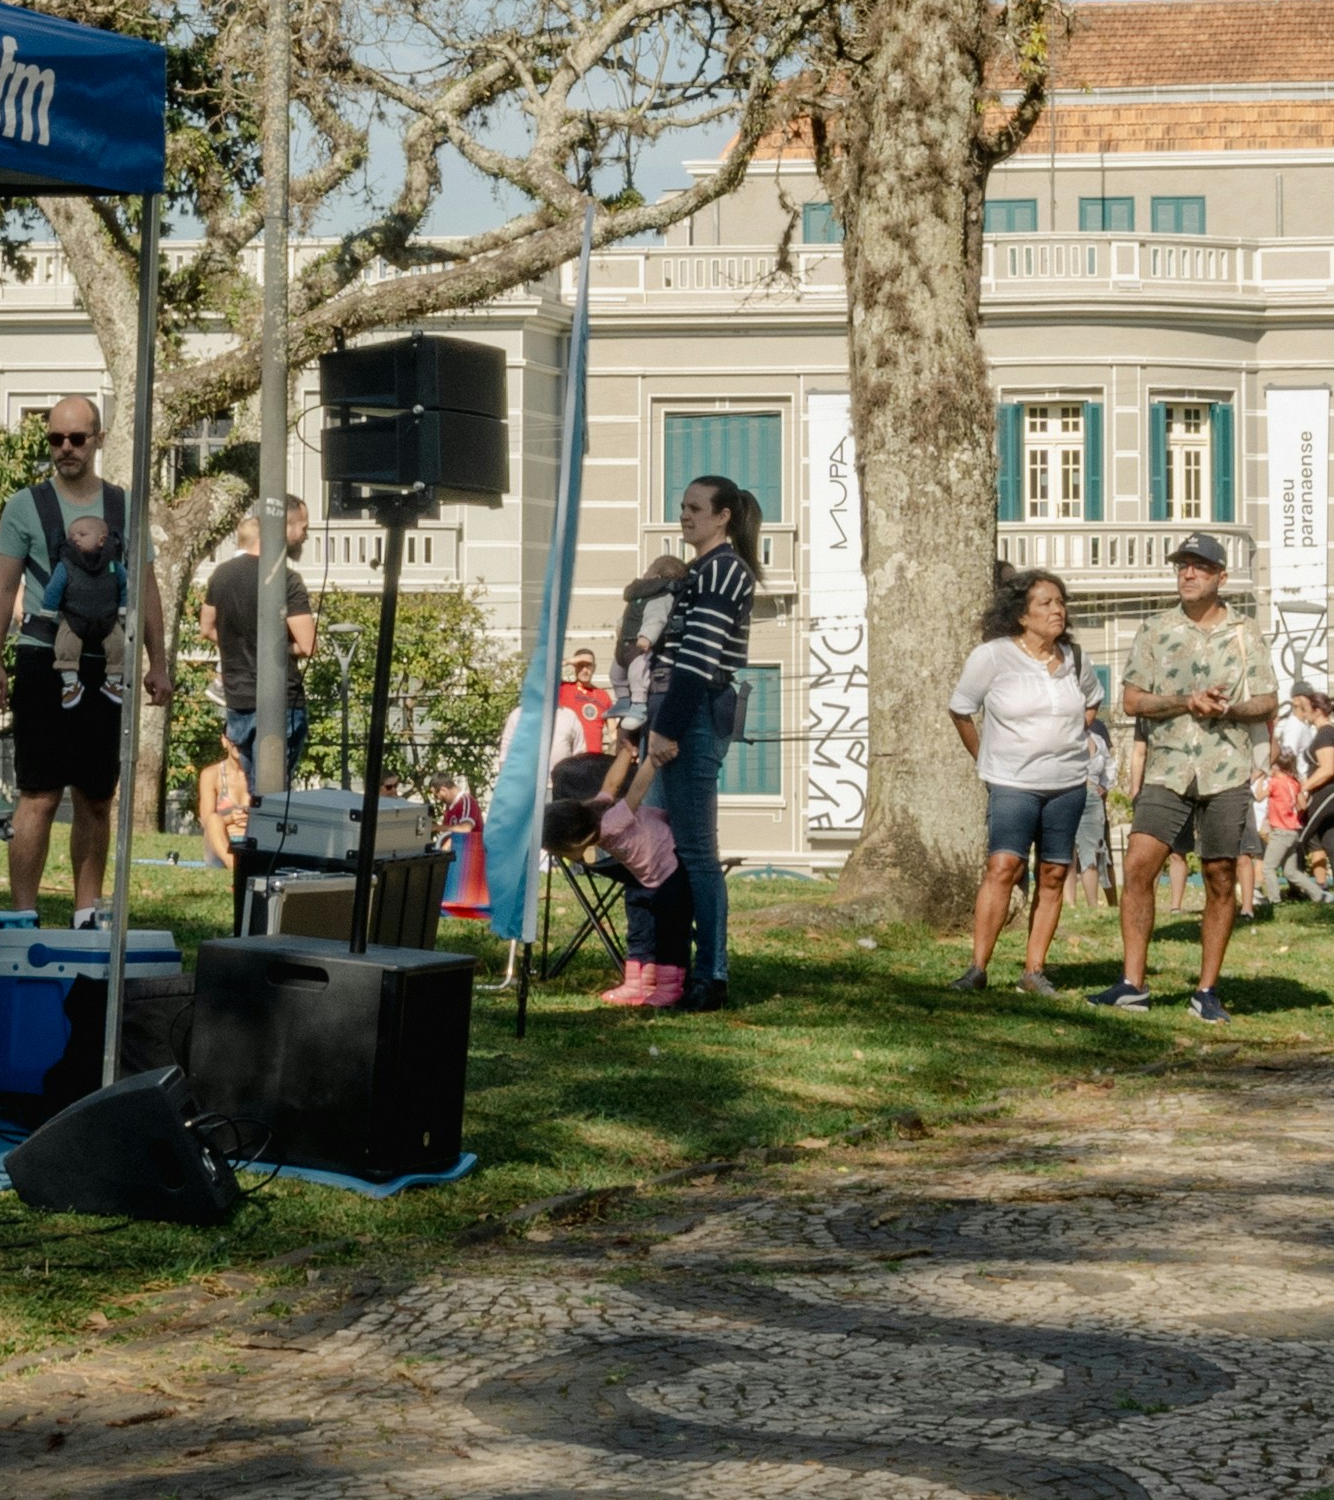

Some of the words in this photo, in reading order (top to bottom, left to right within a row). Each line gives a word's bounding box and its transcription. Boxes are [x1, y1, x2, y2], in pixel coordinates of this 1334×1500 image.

[829, 435, 848, 550] MUPA
[1282, 478, 1295, 549] museu
[1300, 430, 1319, 549] paranaense
